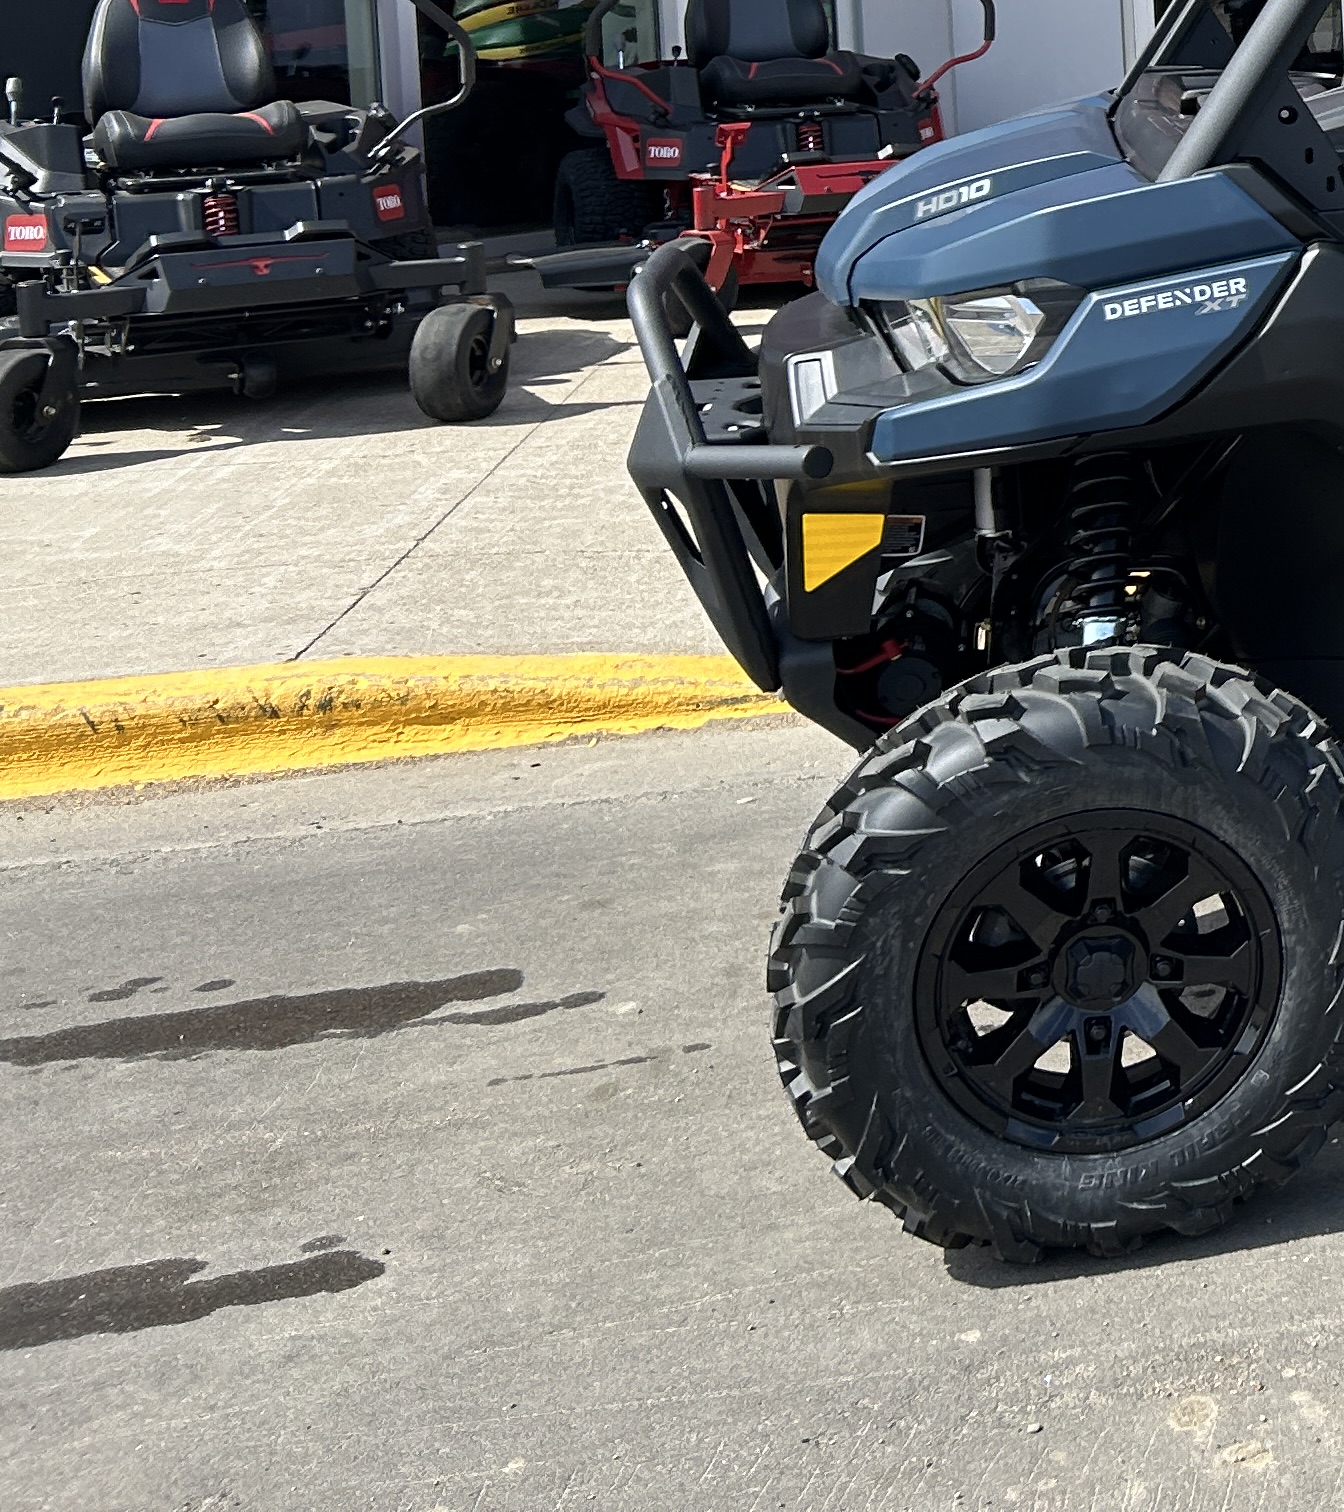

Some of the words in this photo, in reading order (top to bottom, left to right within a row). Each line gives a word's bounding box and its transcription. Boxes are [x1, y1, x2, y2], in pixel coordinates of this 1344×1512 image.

[648, 146, 680, 158] TORO
[376, 194, 401, 210] TORO
[915, 178, 992, 219] HD10
[8, 225, 45, 240] TORO
[1105, 277, 1247, 321] DEFENDER
[1196, 294, 1247, 317] XT
